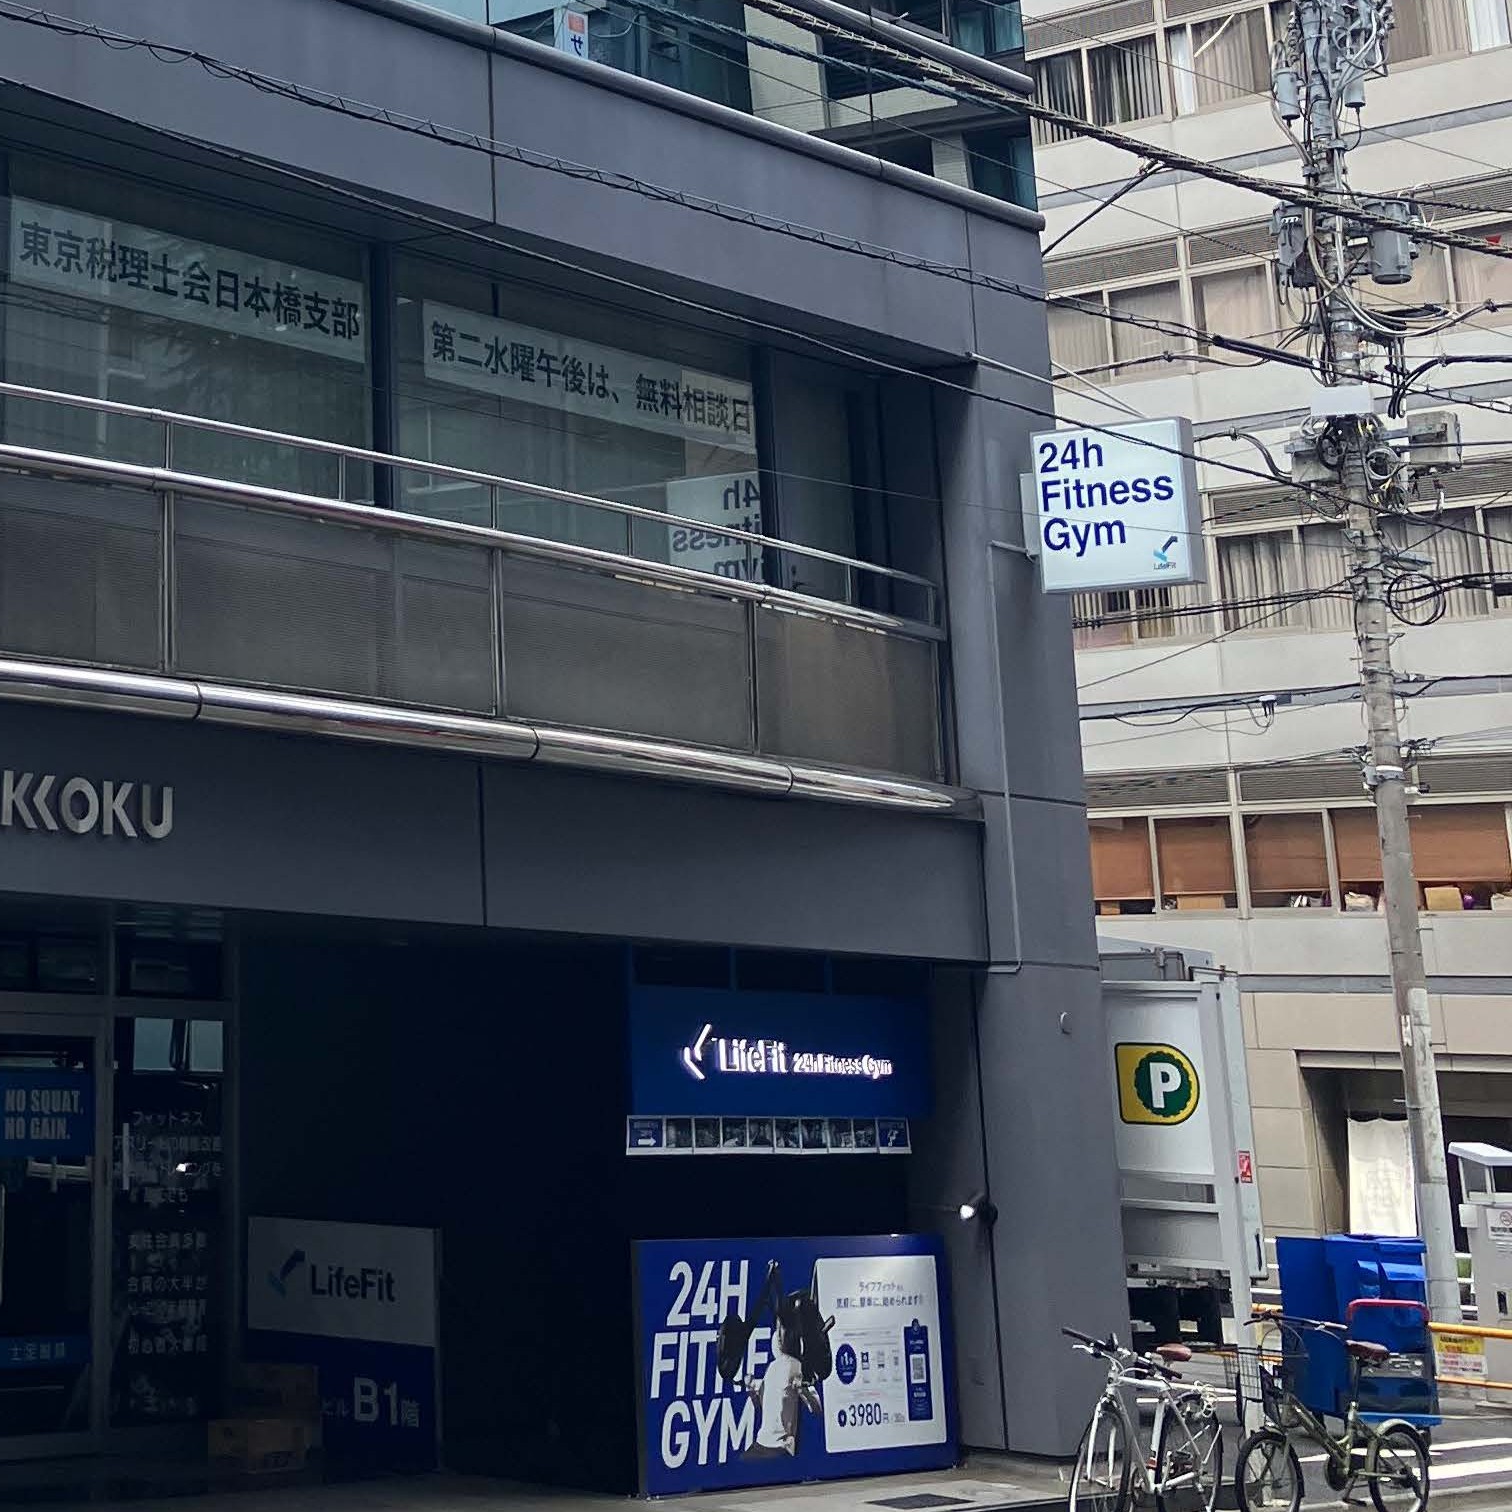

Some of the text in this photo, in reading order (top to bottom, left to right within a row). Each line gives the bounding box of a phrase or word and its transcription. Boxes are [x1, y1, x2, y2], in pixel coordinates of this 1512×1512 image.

[18, 220, 361, 343] 東京税理士会日本橋支部
[1039, 437, 1104, 474] 24h
[1041, 475, 1175, 513] Fitness
[1043, 517, 1127, 558] Gym
[718, 1038, 789, 1073] LifeFit
[5, 1089, 26, 1113] NO
[1149, 1062, 1182, 1108] P
[4, 1117, 26, 1140] NO
[311, 1263, 396, 1303] LifeFit
[666, 1259, 749, 1327] 24H
[661, 1395, 756, 1470] GYM
